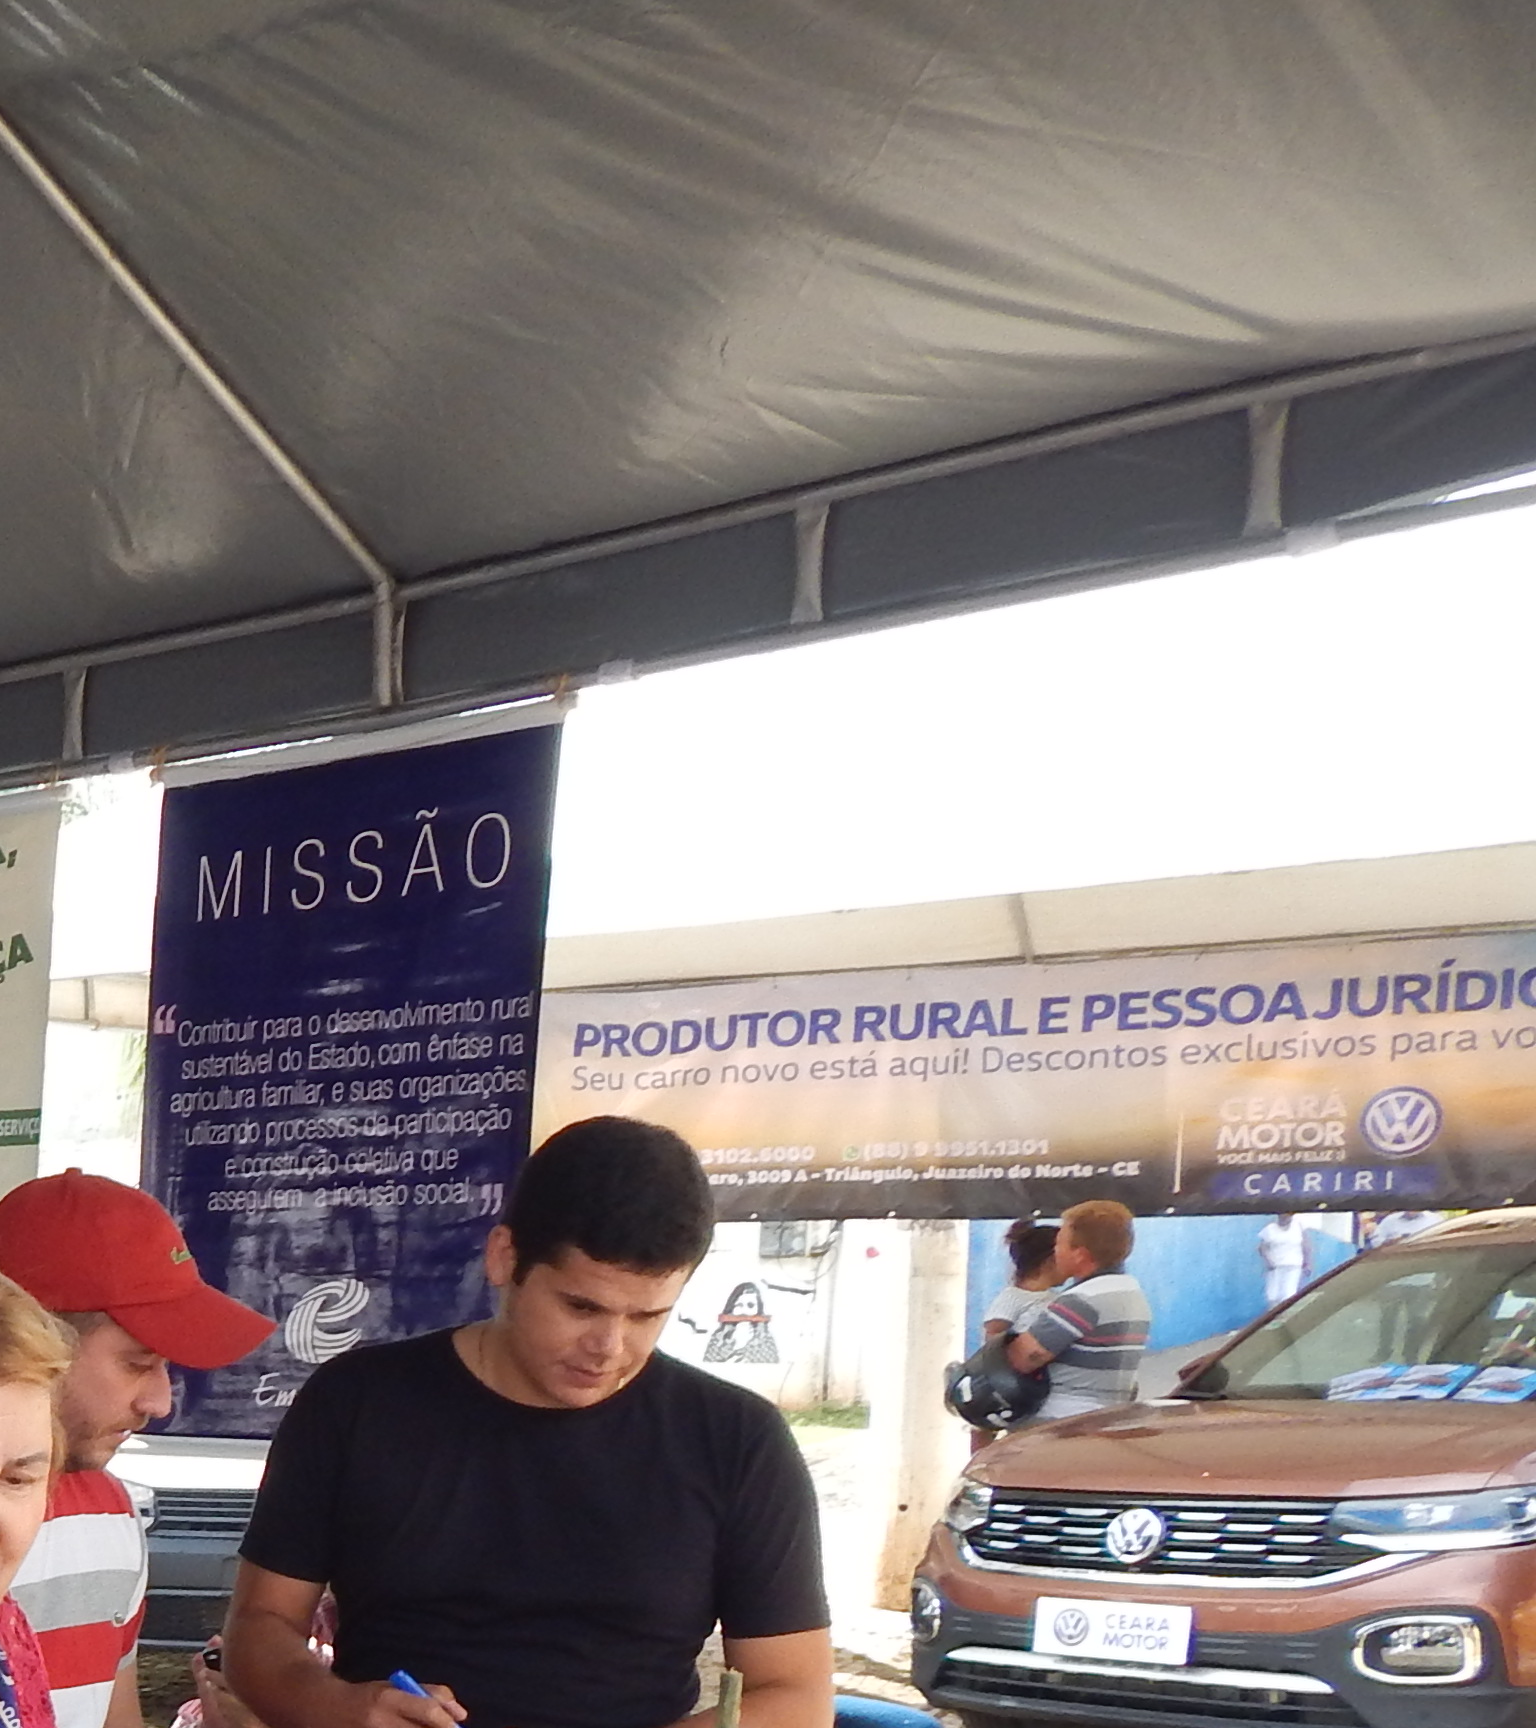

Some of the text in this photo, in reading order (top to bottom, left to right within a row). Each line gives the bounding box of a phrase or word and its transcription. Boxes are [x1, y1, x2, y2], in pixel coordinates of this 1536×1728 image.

[196, 807, 511, 922] MISSÃO
[263, 1016, 302, 1044] para
[309, 1015, 321, 1036] o
[327, 998, 485, 1034] desenvolvimento
[491, 991, 534, 1020] rural
[573, 1008, 841, 1058] PRODUTOR
[853, 997, 1027, 1043] RURAL
[1037, 996, 1071, 1035] E
[1081, 981, 1307, 1033] PESSOA
[181, 1032, 524, 1080] sustentável do Estado, com ênfase na
[571, 1065, 624, 1092] Seu
[633, 1066, 711, 1092] carro
[720, 1060, 799, 1086] novo
[810, 1050, 878, 1081] está
[888, 1048, 968, 1083] aqui!
[982, 1043, 1167, 1073] Descontos
[1179, 1030, 1376, 1066] exclusivos
[1390, 1026, 1478, 1061] para
[170, 1065, 526, 1118] agricultura familiar, e suas organizações
[185, 1103, 512, 1147] utilizando processos de participação
[1216, 1121, 1346, 1150] MOTOR
[225, 1146, 458, 1181] e construção coletiva que
[1244, 1171, 1393, 1194] CARIRI
[208, 1188, 302, 1215] assegurem
[314, 1187, 326, 1208] a
[331, 1180, 408, 1207] inclusão
[1102, 1632, 1169, 1650] MOTOR
